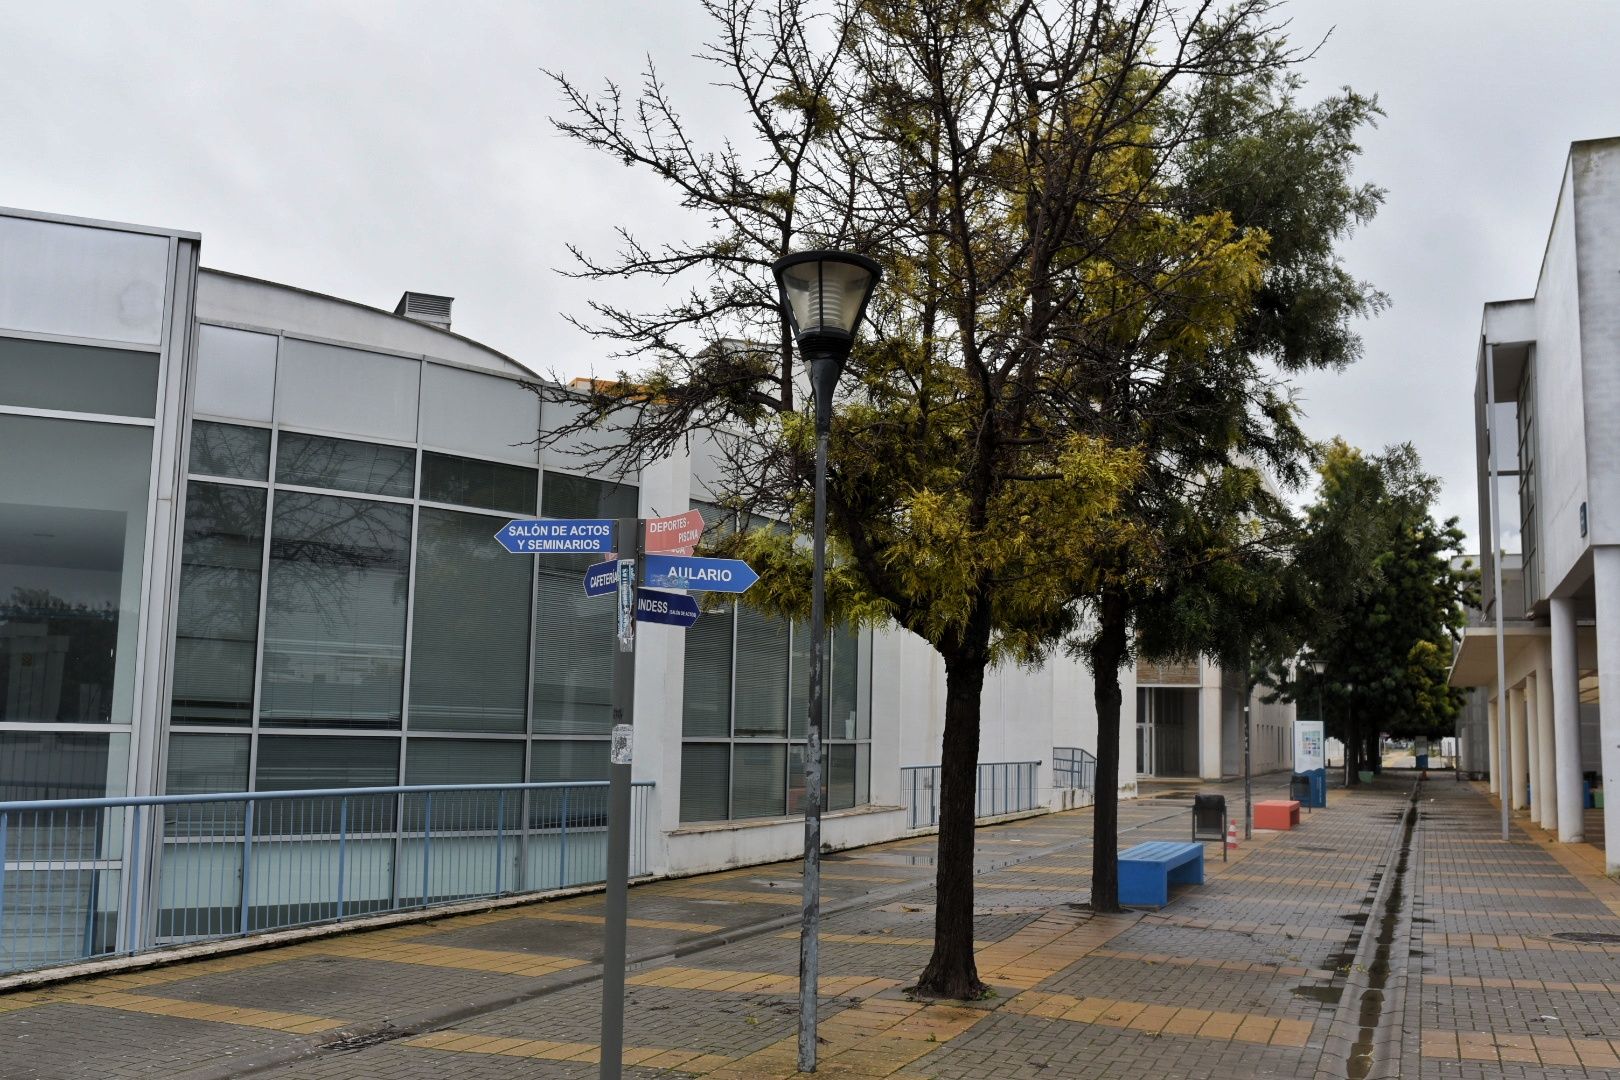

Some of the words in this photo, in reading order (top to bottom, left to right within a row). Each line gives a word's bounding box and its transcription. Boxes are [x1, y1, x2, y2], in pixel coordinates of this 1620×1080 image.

[508, 523, 548, 537] SALÓN
[552, 525, 567, 536] DE
[570, 525, 610, 536] ACTOS
[650, 517, 686, 533] DEPORTES
[678, 529, 699, 543] PISCINA
[517, 539, 525, 550] Y
[527, 539, 600, 550] SEMINARIOS
[667, 566, 732, 582] AULARIO
[638, 598, 668, 613] INDESS
